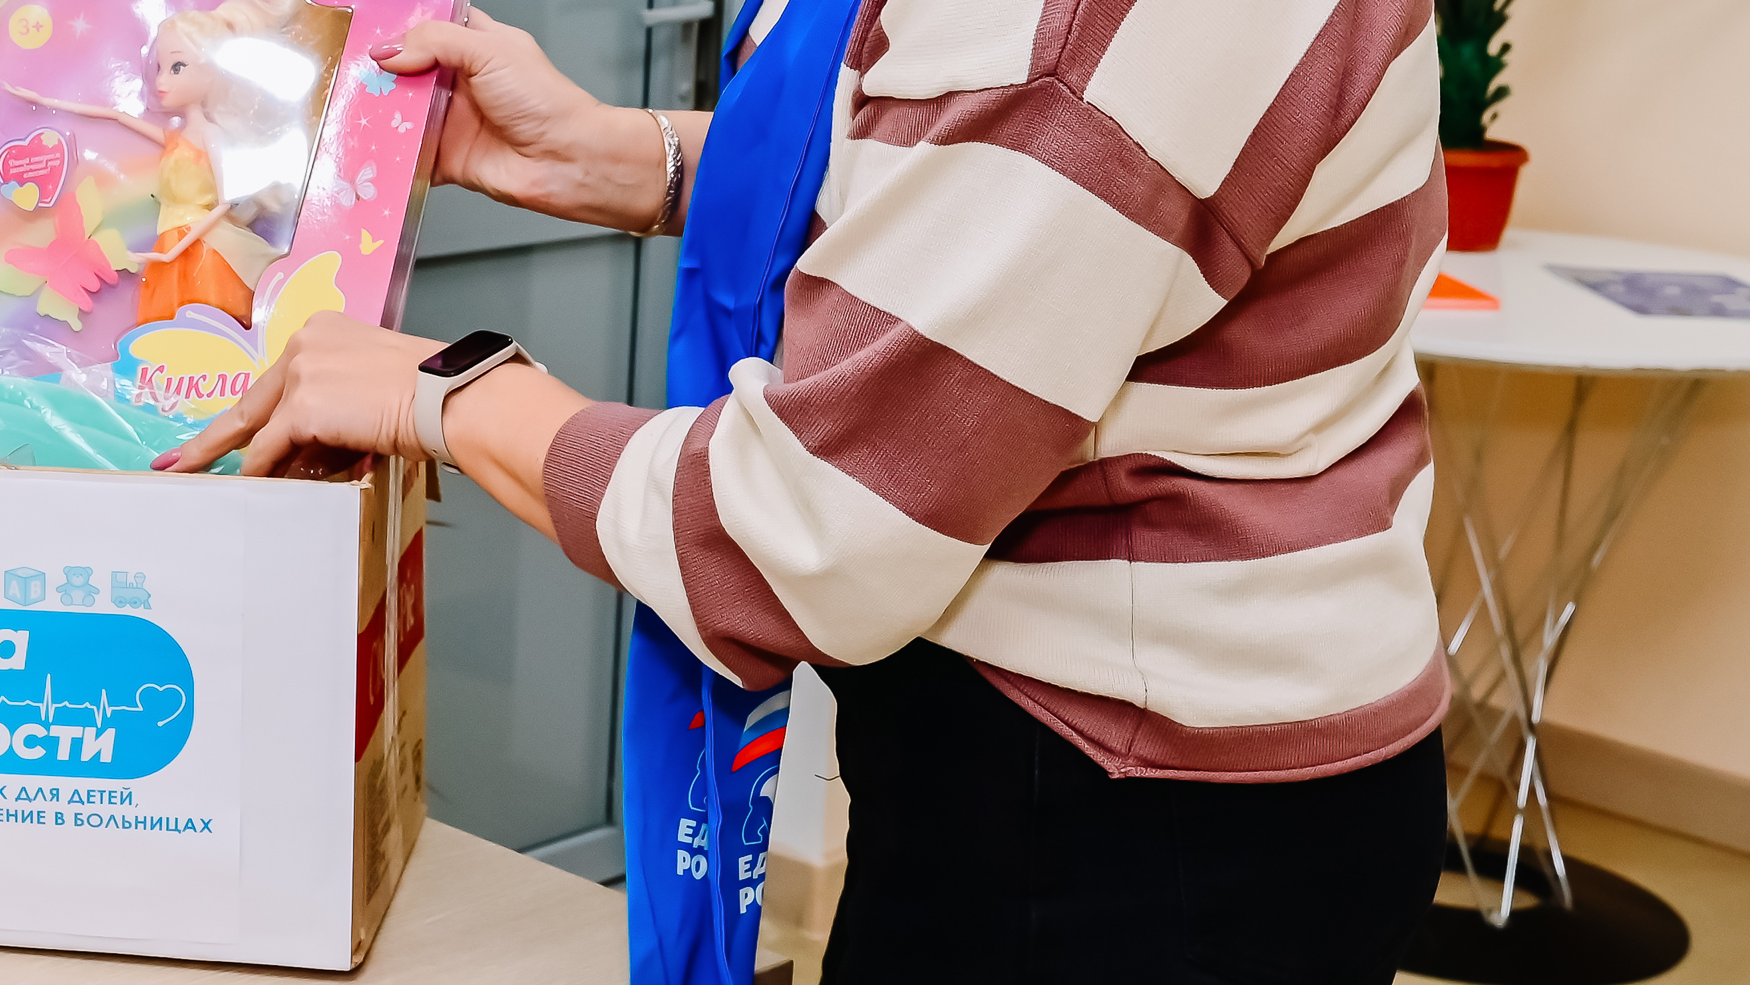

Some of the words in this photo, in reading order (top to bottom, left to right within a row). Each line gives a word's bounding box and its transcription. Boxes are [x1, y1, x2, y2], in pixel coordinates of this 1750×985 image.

[18, 17, 45, 36] 3+
[134, 364, 251, 413] Кукла
[15, 786, 60, 803] ДЛЯ
[68, 787, 139, 808] ДЕТЕЙ,
[55, 812, 65, 826] В
[74, 813, 213, 834] БОЛЬНИЦАХ
